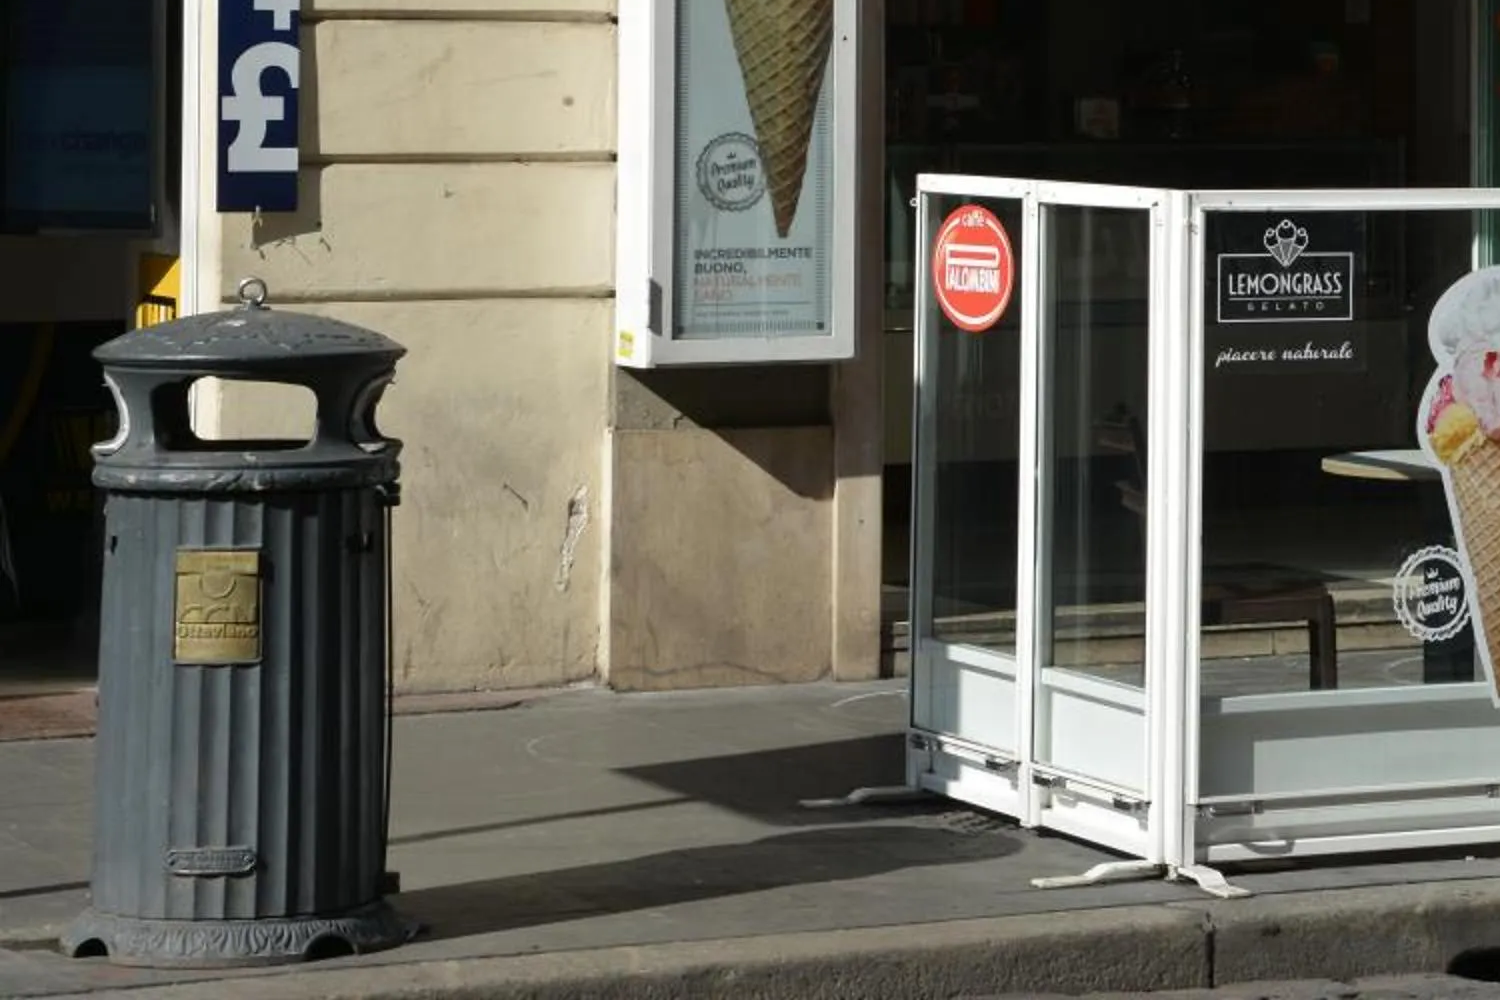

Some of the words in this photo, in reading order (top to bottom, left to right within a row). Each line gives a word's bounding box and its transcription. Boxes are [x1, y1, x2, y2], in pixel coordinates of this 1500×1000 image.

[1228, 271, 1343, 295] LEMONGRASS
[1247, 301, 1326, 311] GELATO
[1215, 347, 1277, 368] piacere
[1281, 341, 1354, 360] naturale
[1416, 594, 1458, 621] Quality
